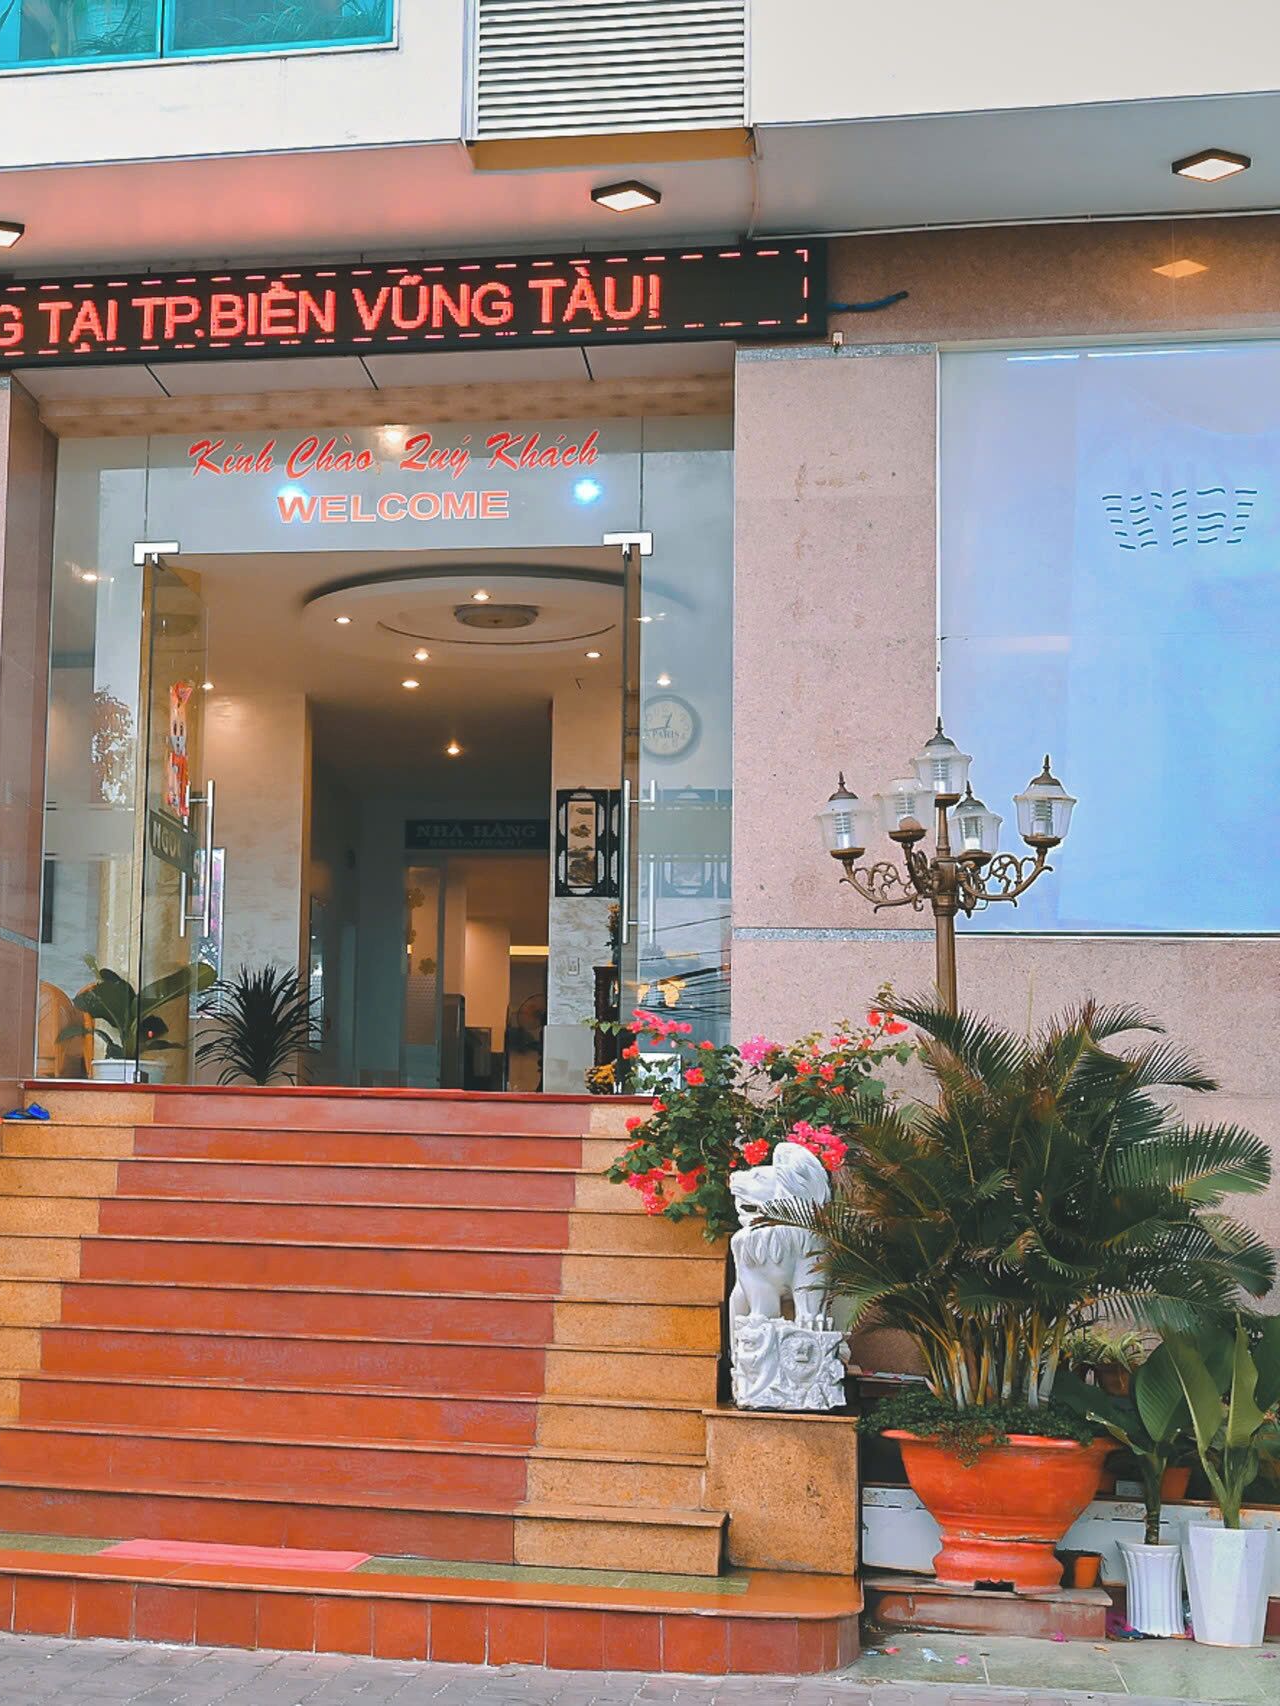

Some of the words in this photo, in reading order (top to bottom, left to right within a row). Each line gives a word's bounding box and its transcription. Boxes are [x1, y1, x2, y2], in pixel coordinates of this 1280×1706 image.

[38, 299, 119, 352] TẠI
[351, 274, 514, 331] VŨNG
[527, 266, 662, 324] TÀU!
[188, 438, 277, 478] Kính
[399, 431, 472, 480] Quý
[485, 429, 600, 472] Khách
[276, 491, 510, 523] WELCOME
